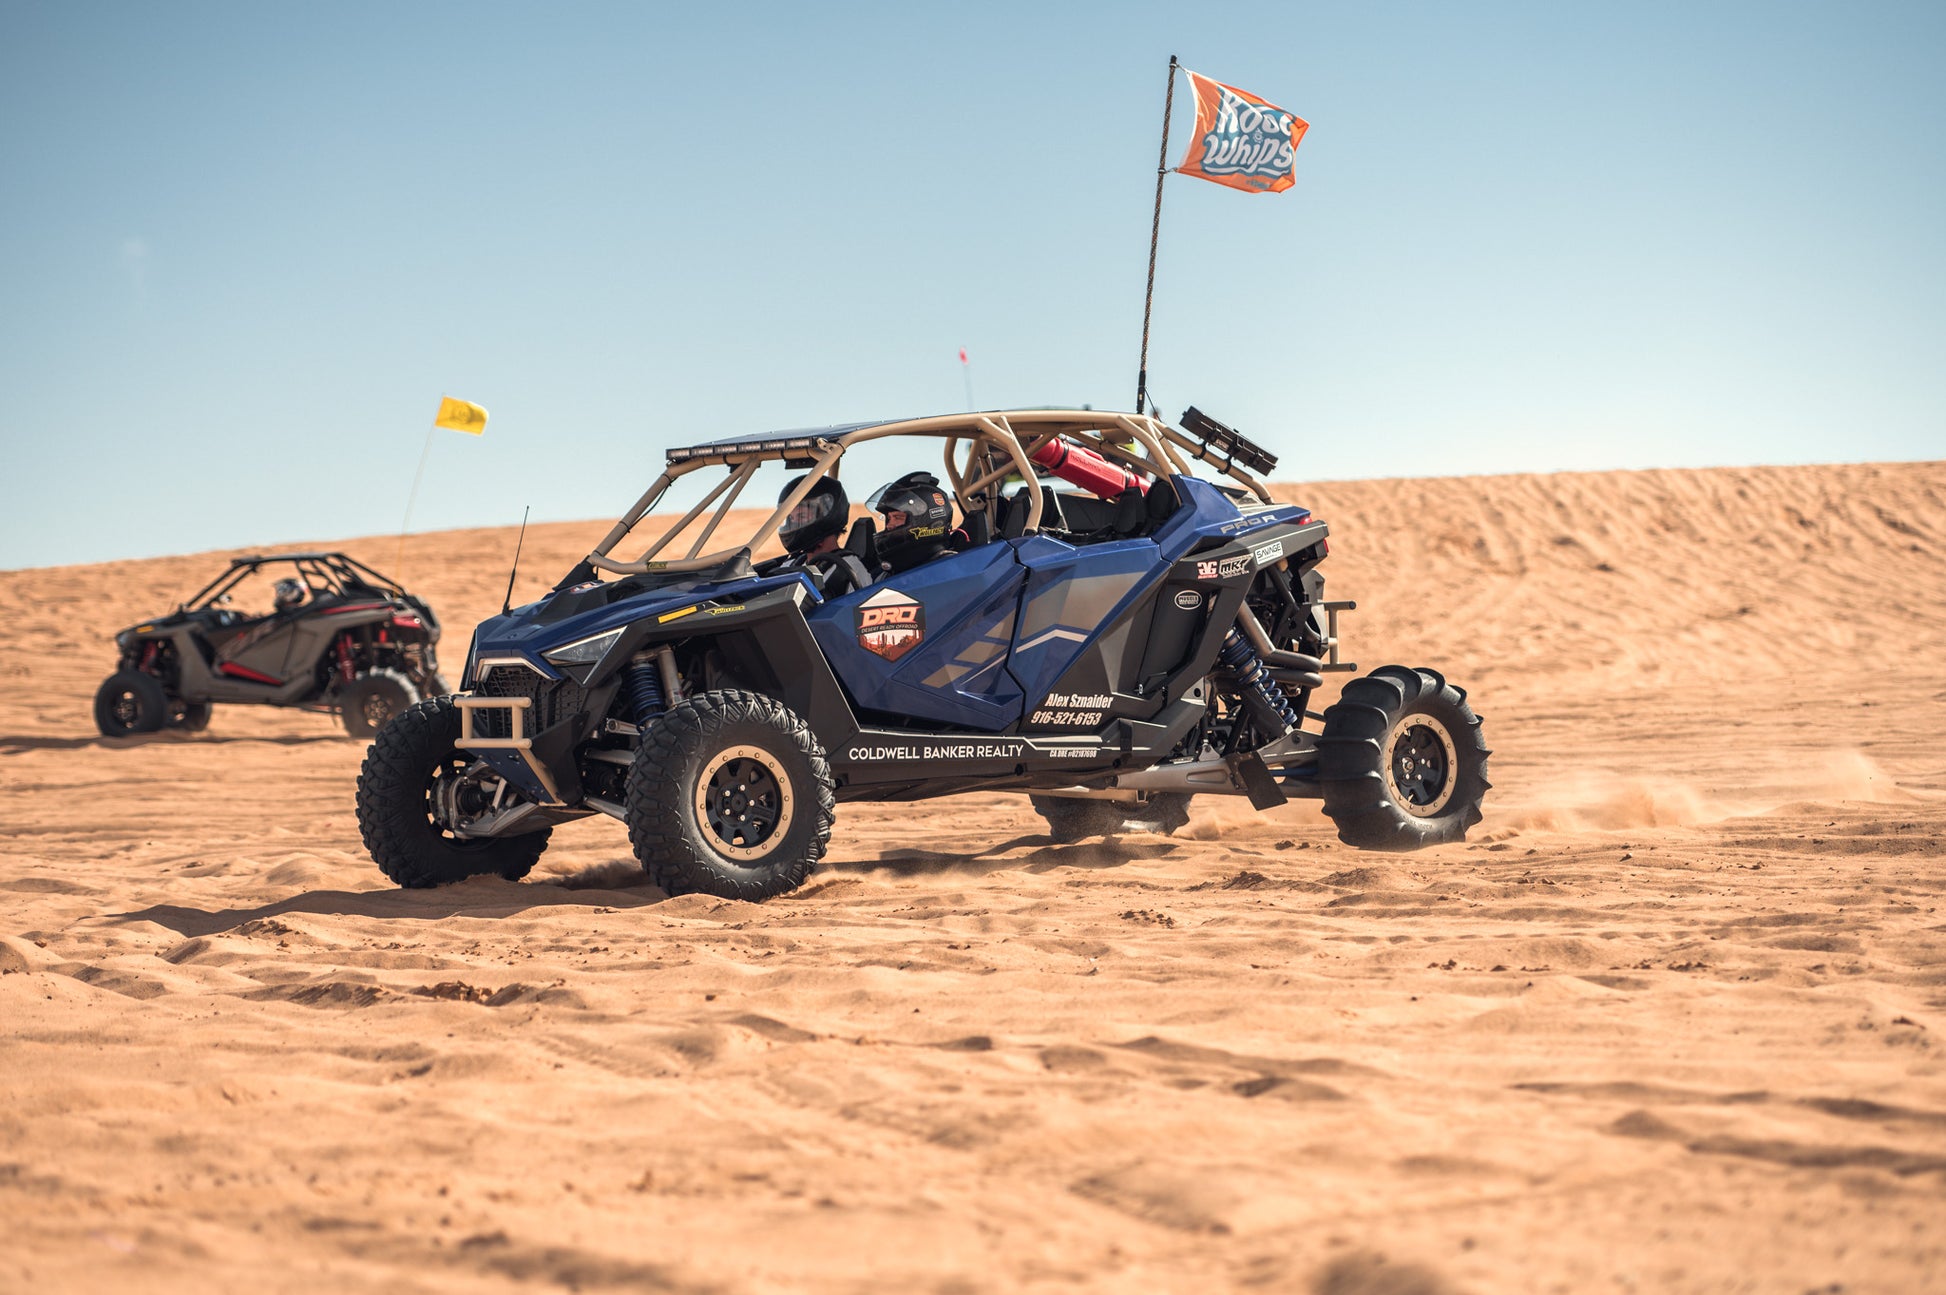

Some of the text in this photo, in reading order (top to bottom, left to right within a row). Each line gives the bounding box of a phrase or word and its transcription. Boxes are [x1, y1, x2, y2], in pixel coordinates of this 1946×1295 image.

[1220, 515, 1277, 534] PRO R
[859, 606, 923, 629] DRO
[861, 626, 880, 634] DESERT
[1045, 693, 1114, 709] Alex Sznaider
[1031, 711, 1102, 726] 916-521-6153
[848, 744, 1025, 761] COLDWELL BANKER REALTY
